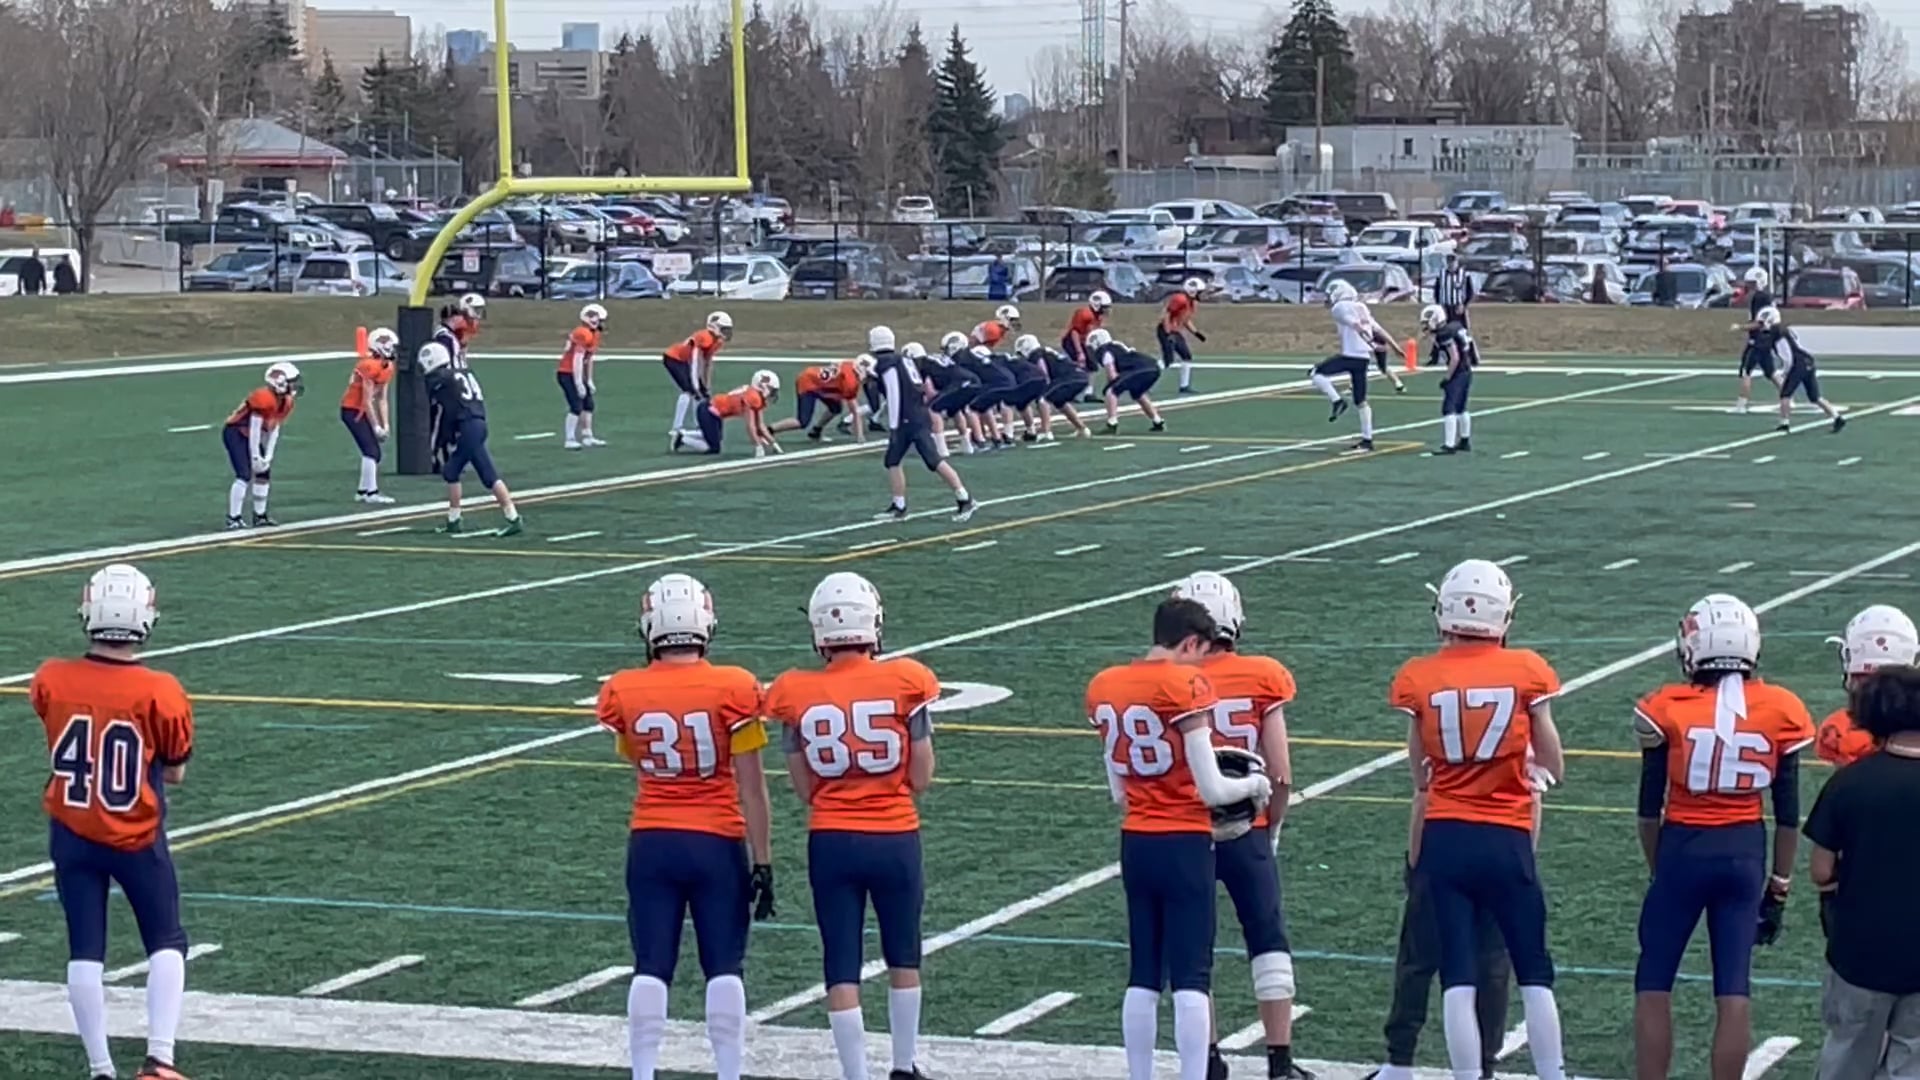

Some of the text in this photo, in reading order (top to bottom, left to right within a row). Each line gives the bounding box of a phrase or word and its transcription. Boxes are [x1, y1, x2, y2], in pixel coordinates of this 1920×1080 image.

[632, 710, 719, 781] 31
[800, 698, 903, 780] 85
[1094, 703, 1174, 777] 28
[1212, 697, 1258, 751] 5
[1429, 686, 1516, 765] 17
[1686, 725, 1772, 795] 16
[51, 713, 143, 812] 40
